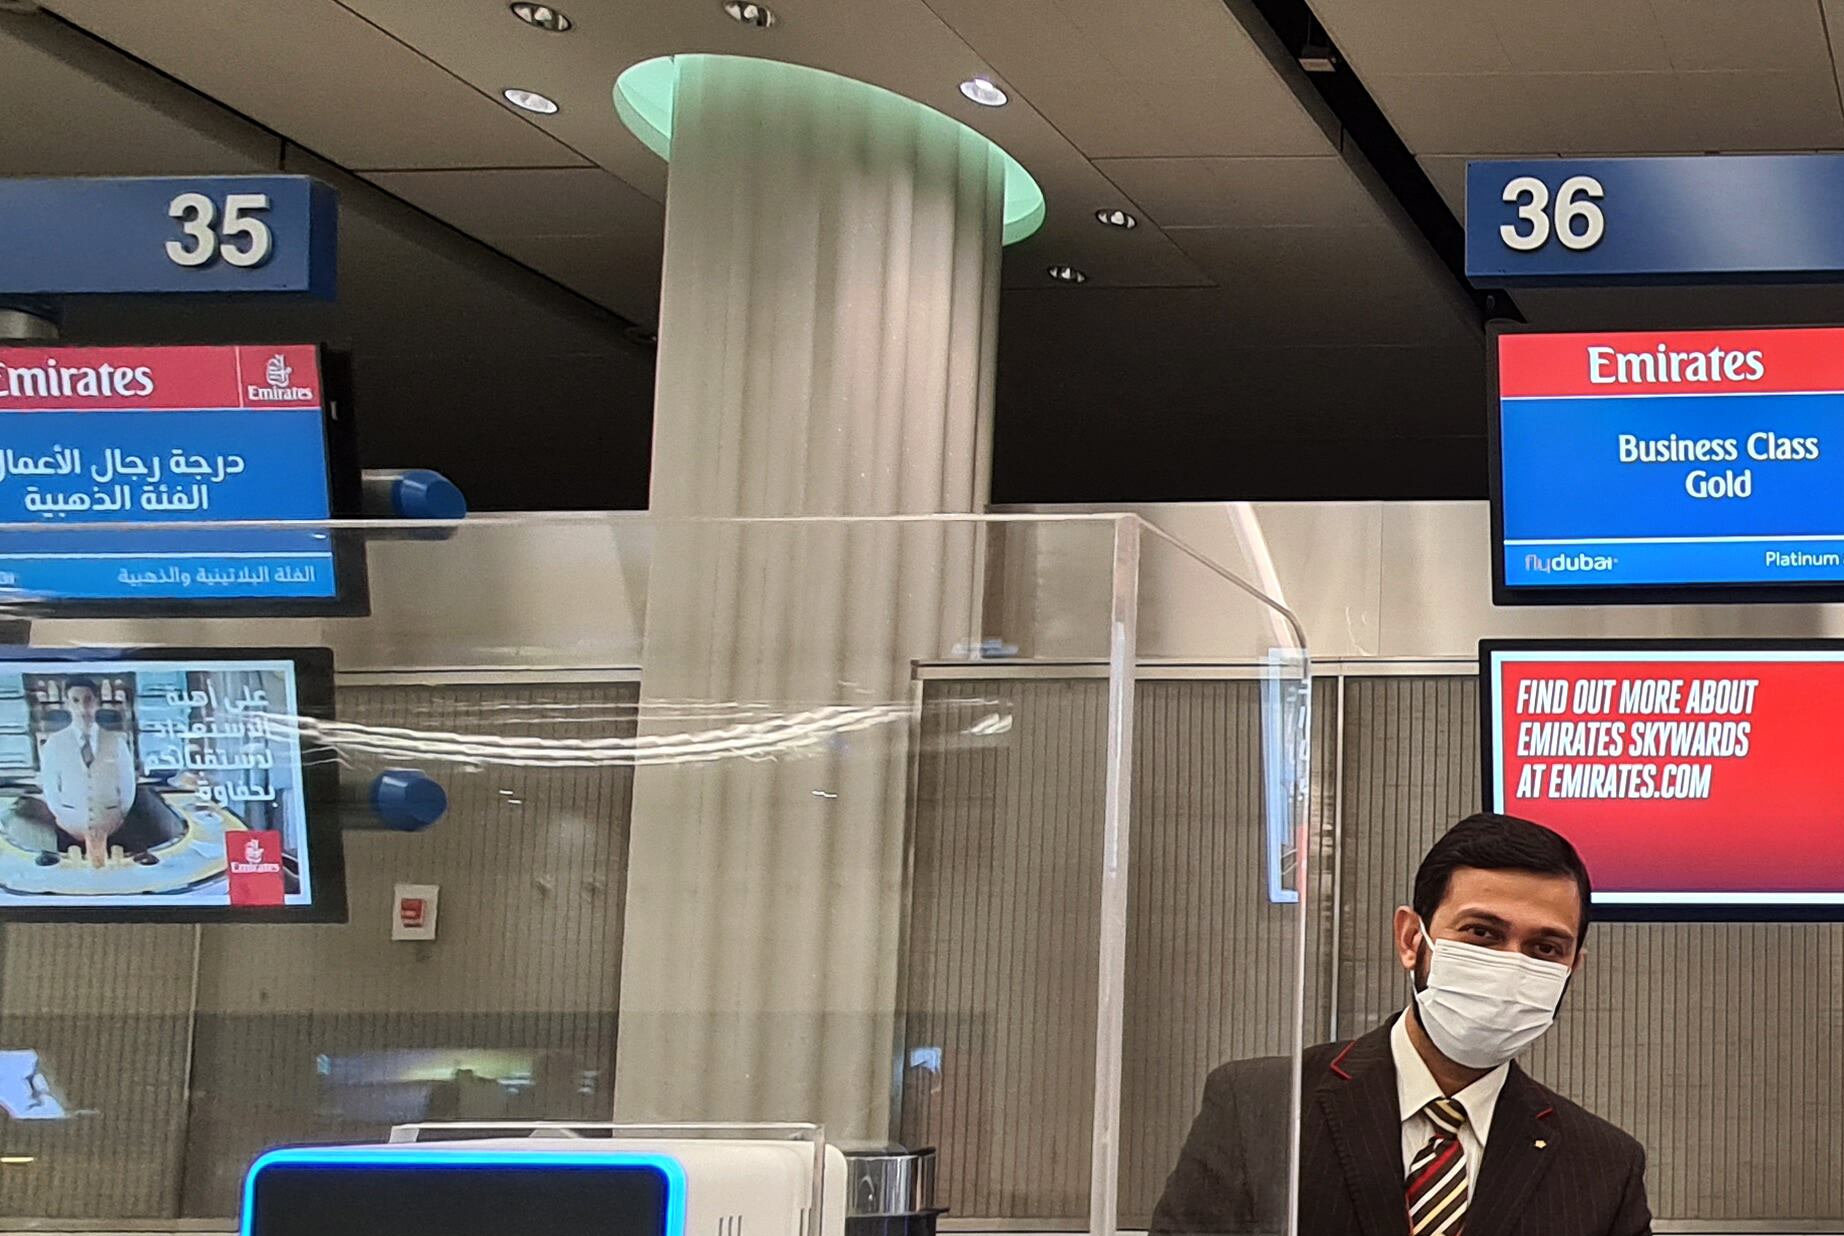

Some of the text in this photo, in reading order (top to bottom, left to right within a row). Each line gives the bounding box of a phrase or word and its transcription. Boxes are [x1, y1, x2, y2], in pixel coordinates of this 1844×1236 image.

[165, 192, 271, 268] 35
[1500, 176, 1605, 250] 36
[0, 359, 154, 397] mirates
[1588, 344, 1764, 384] Emirates
[248, 385, 313, 401] Emirates
[1619, 431, 1819, 463] Business Class
[92, 448, 161, 483] رجال
[170, 449, 245, 483] درجة
[25, 484, 209, 517] الفئة الذهبية
[1685, 469, 1752, 498] Gold
[1525, 553, 1613, 574] flydubai
[1765, 552, 1839, 568] Platinum
[1517, 679, 1758, 715] FIND OUT MORE ABOUT
[1517, 722, 1751, 757] EMIRATES SKYWARDS
[1517, 764, 1712, 799] AT EMIRATES.COM
